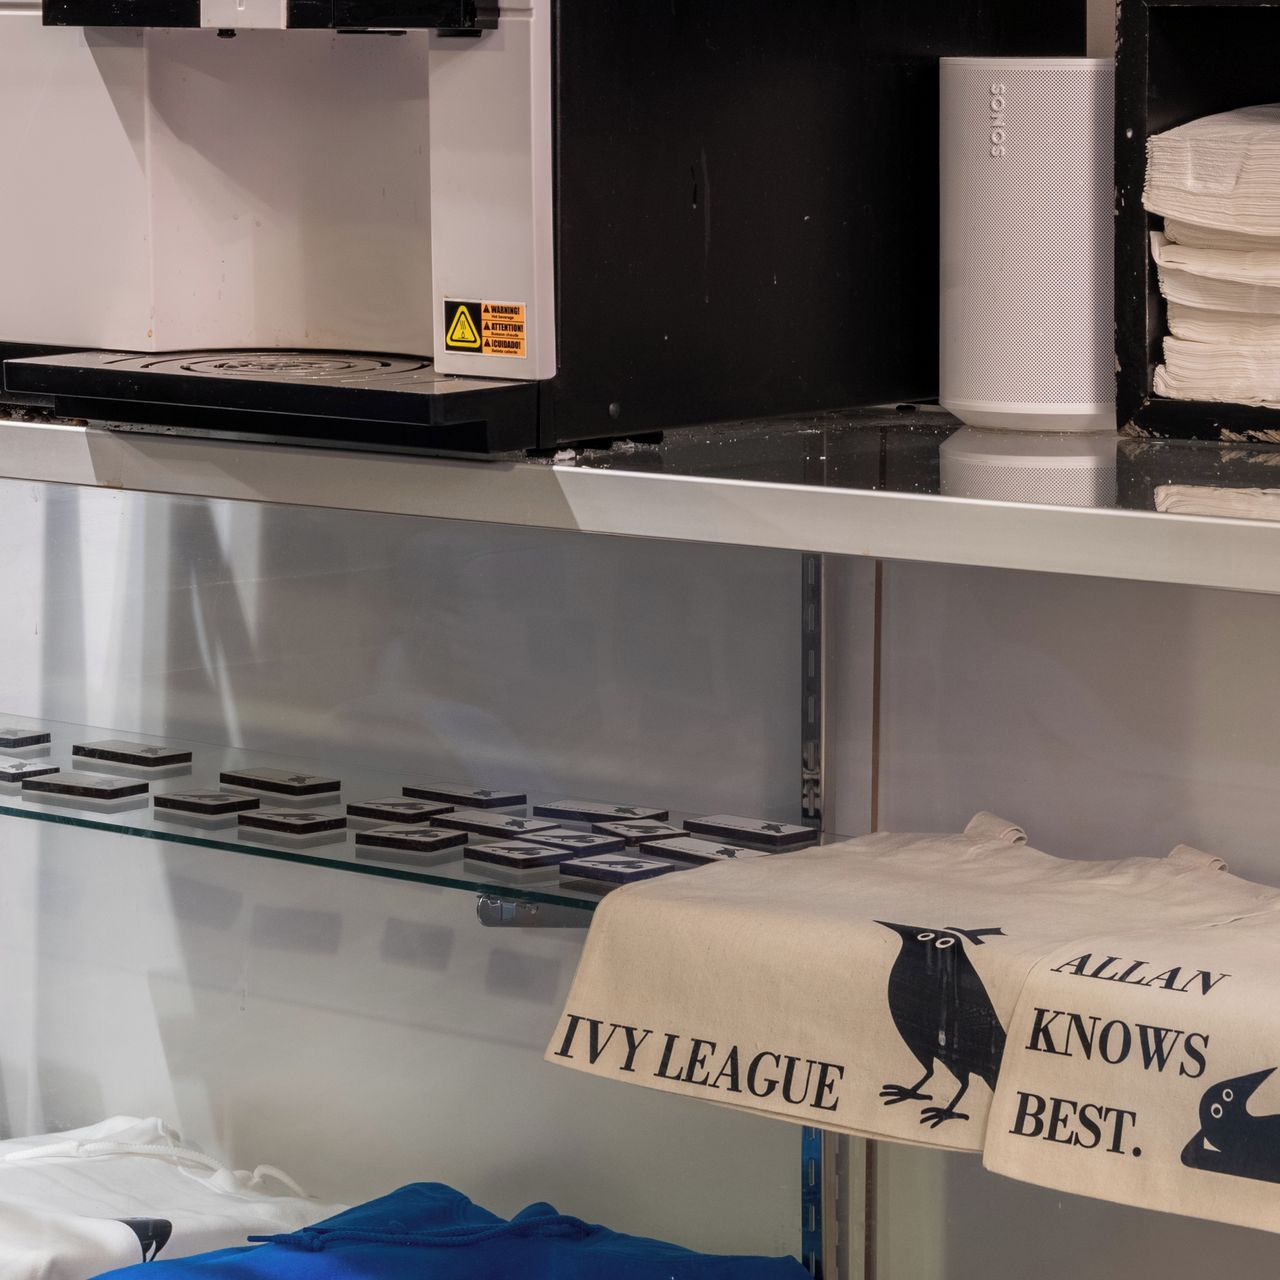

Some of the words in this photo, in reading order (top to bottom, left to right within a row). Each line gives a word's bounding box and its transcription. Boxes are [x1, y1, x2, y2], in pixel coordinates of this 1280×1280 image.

[990, 83, 1005, 157] SONOS
[491, 306, 520, 314] WARNING!
[491, 322, 524, 332] ATTENTION!
[1050, 952, 1232, 997] ALLAN
[553, 1013, 654, 1073] IVY
[653, 1032, 846, 1112] LEAGUE
[1025, 1007, 1210, 1079] KNOWS
[1008, 1091, 1144, 1158] BEST.
